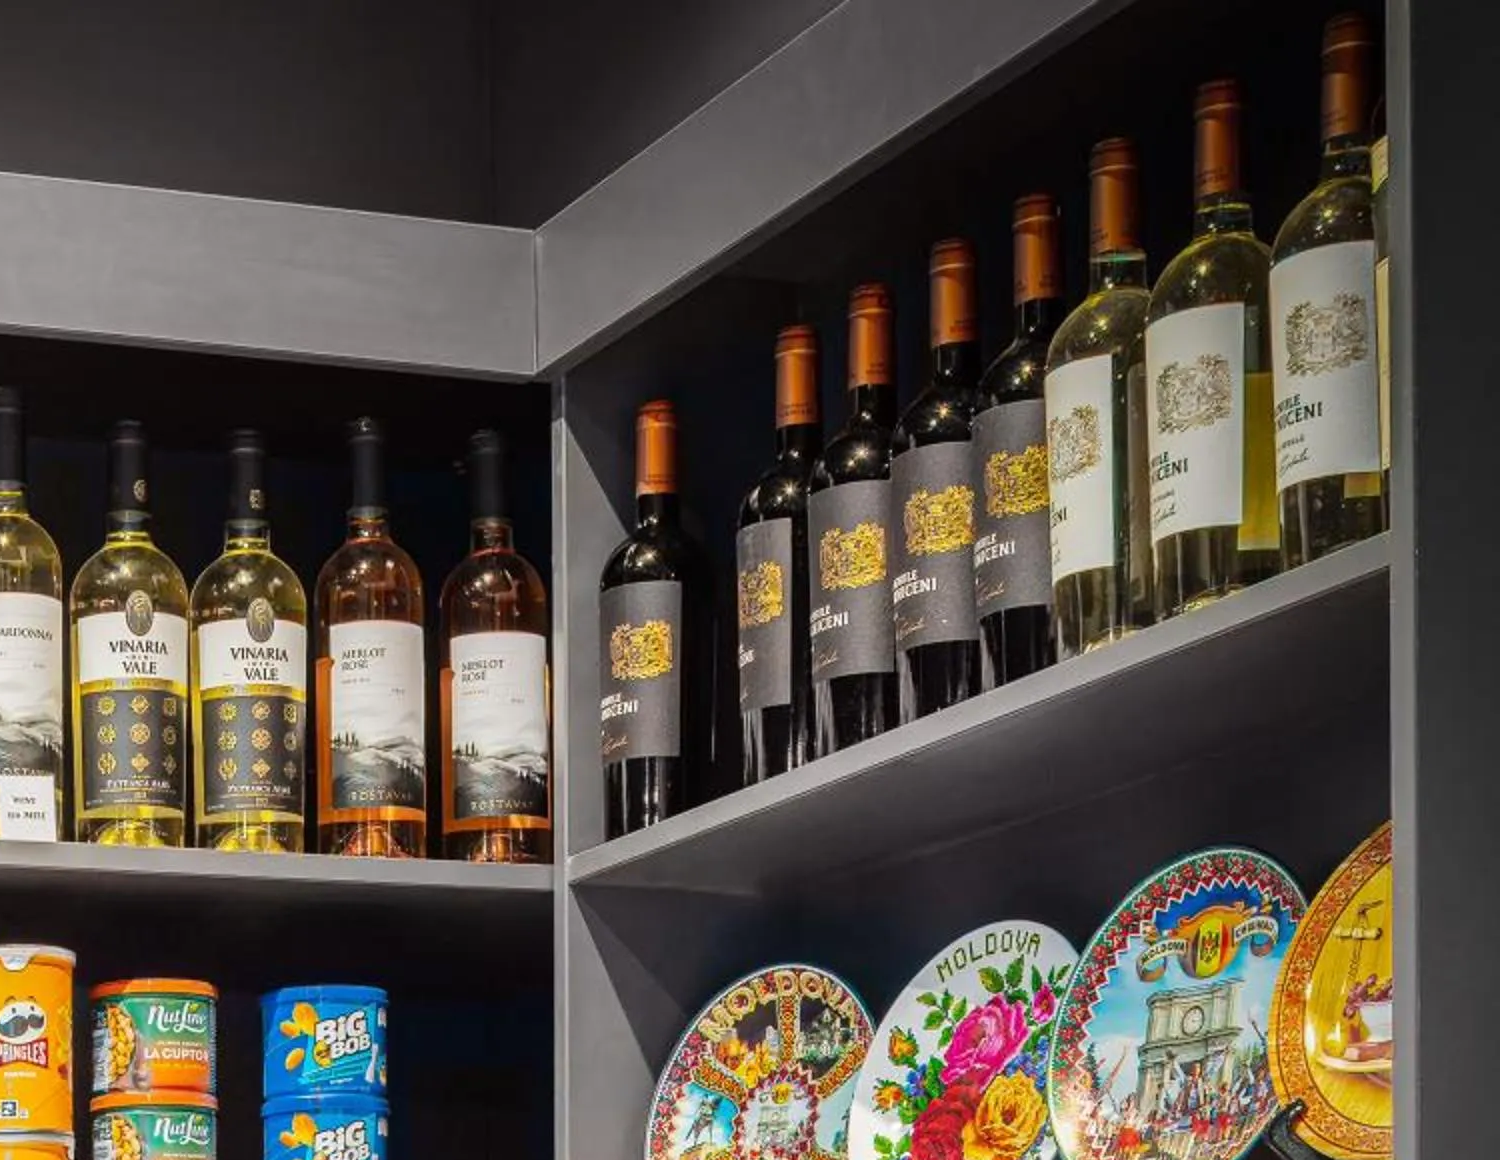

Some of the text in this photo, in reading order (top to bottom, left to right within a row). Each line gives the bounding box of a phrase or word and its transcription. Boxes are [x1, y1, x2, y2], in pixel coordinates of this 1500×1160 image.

[108, 639, 169, 655] VINARIA
[229, 646, 289, 662] VINARIA
[122, 660, 157, 675] VALE
[243, 667, 280, 681] VALE
[936, 929, 1041, 983] MOLDOVA
[698, 968, 858, 1043] MOLDOVA
[315, 1009, 367, 1043] BIG
[143, 1047, 160, 1059] LA
[330, 1033, 371, 1059] BOB
[314, 1120, 366, 1153] BIG
